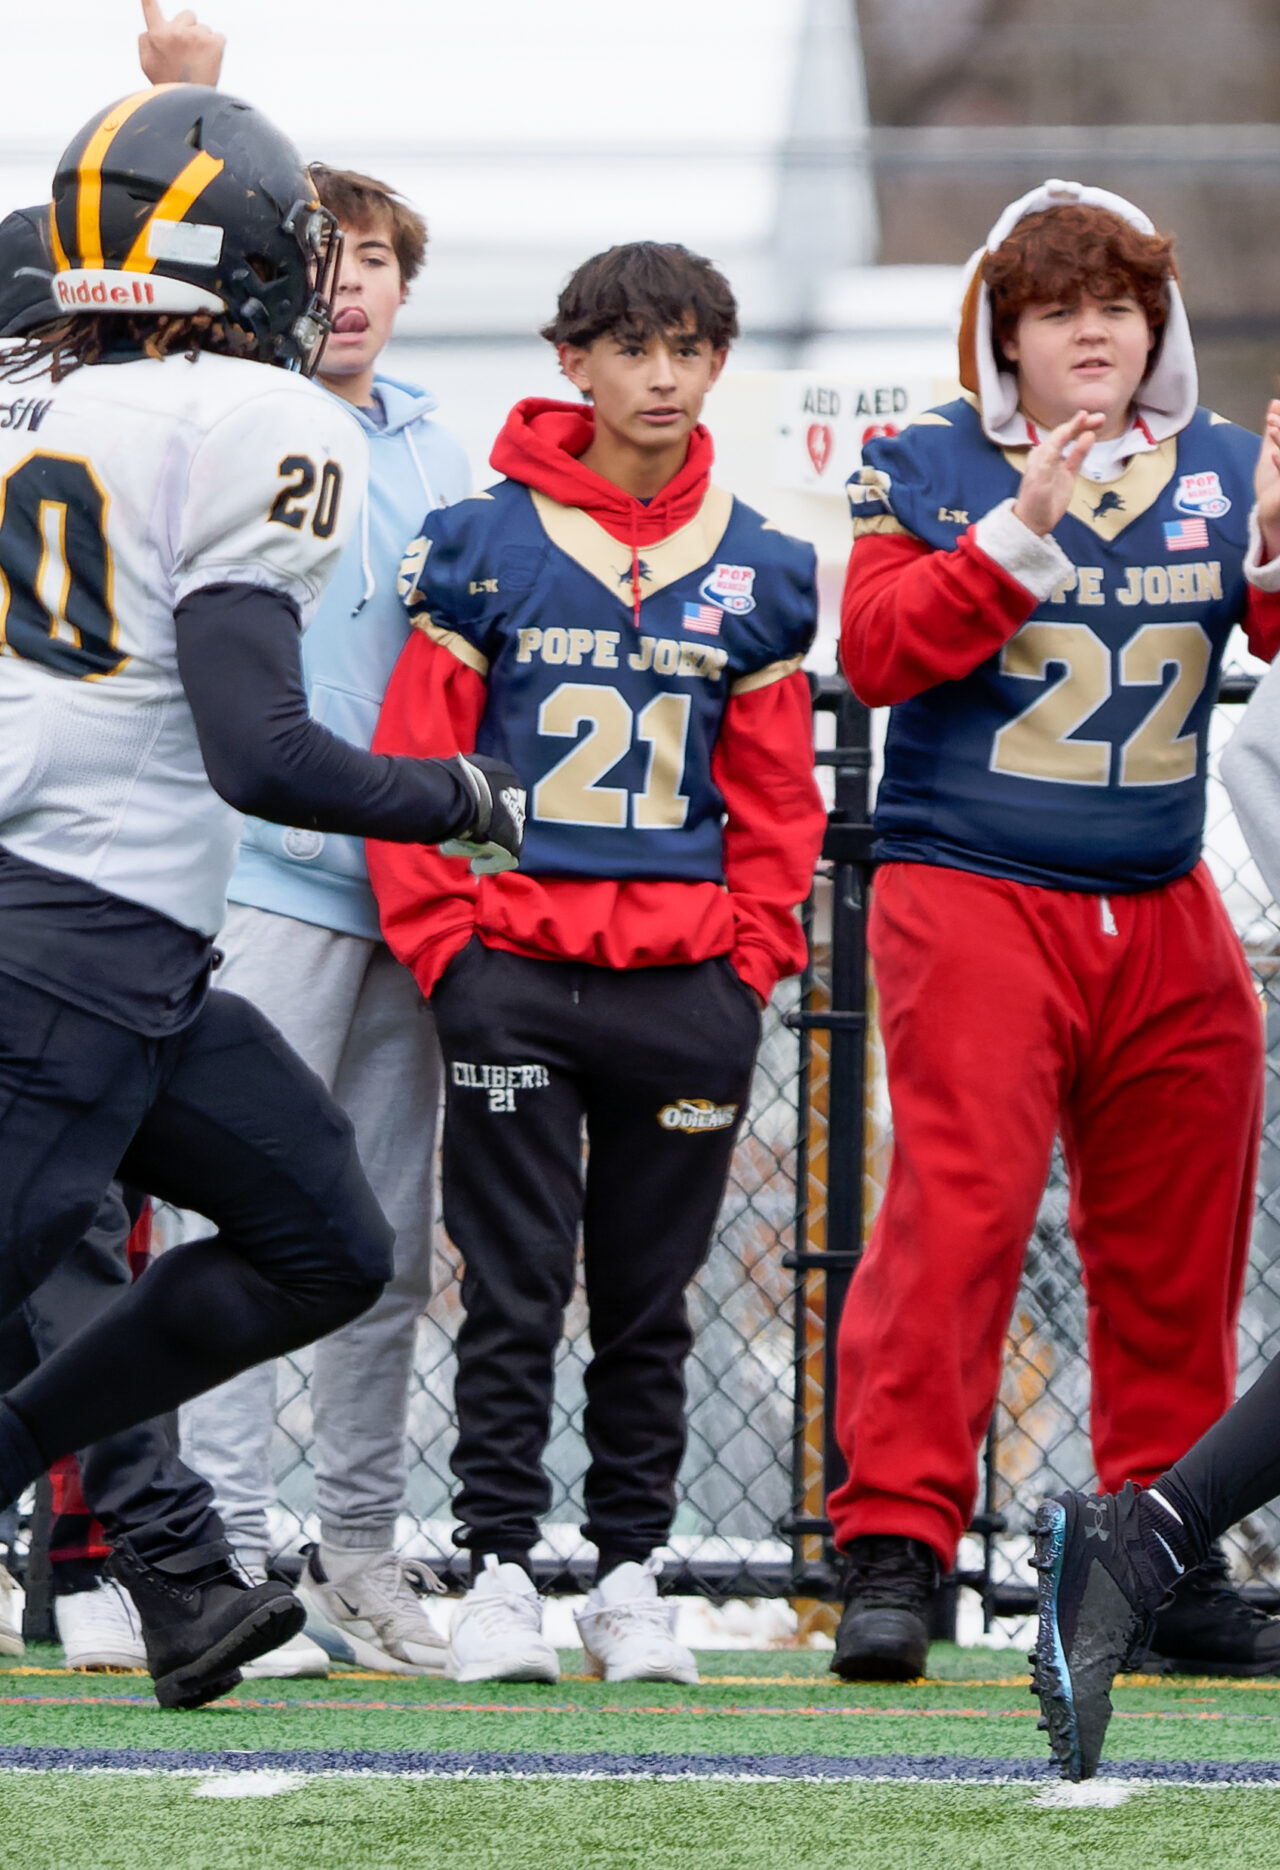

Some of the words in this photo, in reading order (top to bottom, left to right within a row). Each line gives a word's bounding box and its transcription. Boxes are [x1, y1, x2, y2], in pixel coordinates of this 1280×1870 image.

[57, 280, 154, 305] Riddell
[802, 387, 840, 416] AED
[855, 387, 908, 417] AED
[266, 454, 344, 540] 20
[1115, 561, 1223, 606] JOHN
[516, 627, 620, 669] POPE
[989, 621, 1212, 787] 22
[532, 682, 692, 829] 21
[488, 1088, 517, 1112] 21
